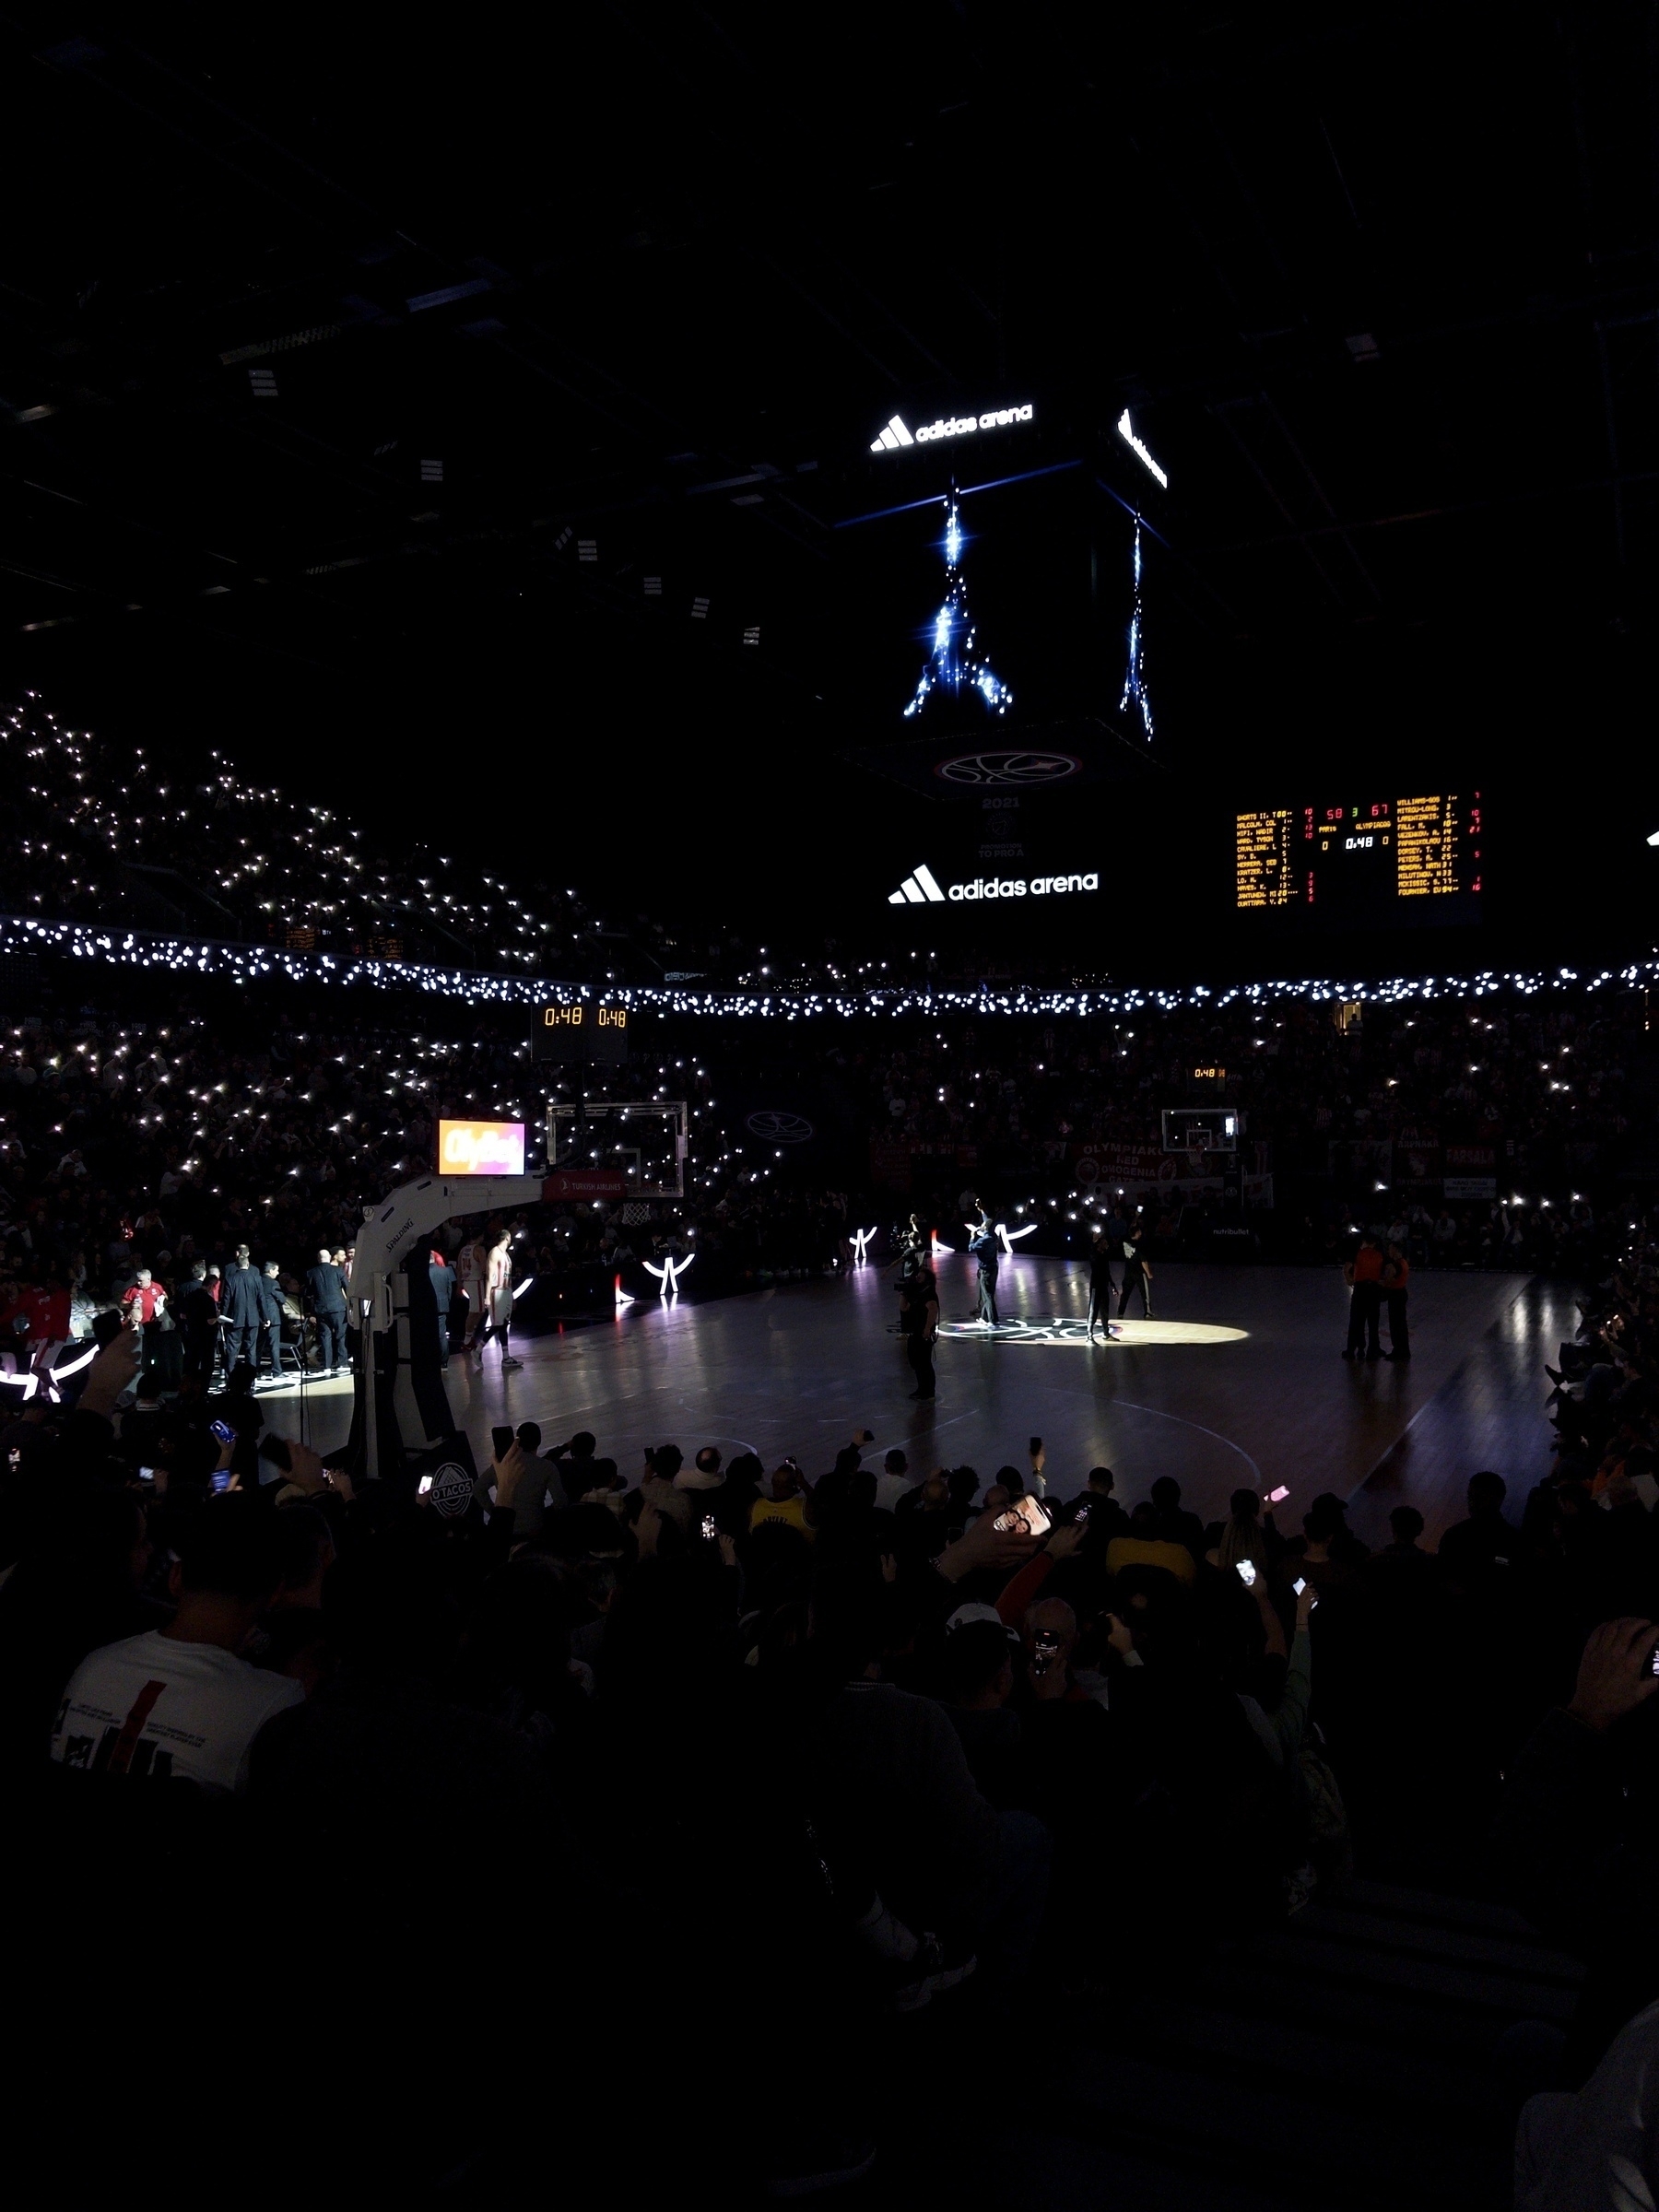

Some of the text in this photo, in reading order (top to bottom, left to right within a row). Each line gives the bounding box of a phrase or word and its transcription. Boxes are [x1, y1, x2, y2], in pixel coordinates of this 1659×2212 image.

[916, 404, 1032, 442] adidas arena
[982, 796, 1020, 809] 2021
[1327, 804, 1388, 820] 58 3 67
[1355, 820, 1392, 830] OLYMPIACOS
[1322, 841, 1328, 850] 0
[1382, 836, 1389, 844] 0
[978, 850, 992, 858] TO
[994, 849, 1016, 858] PRO
[947, 874, 1098, 900] adidas arena
[544, 1006, 582, 1026] 0:48
[598, 1008, 627, 1029] 0:48
[1083, 1142, 1163, 1156] OLYMPIAK
[1101, 1165, 1156, 1177] OMOGENIA
[386, 1218, 414, 1253] SPALDING
[432, 1482, 471, 1500] O'TACOS
